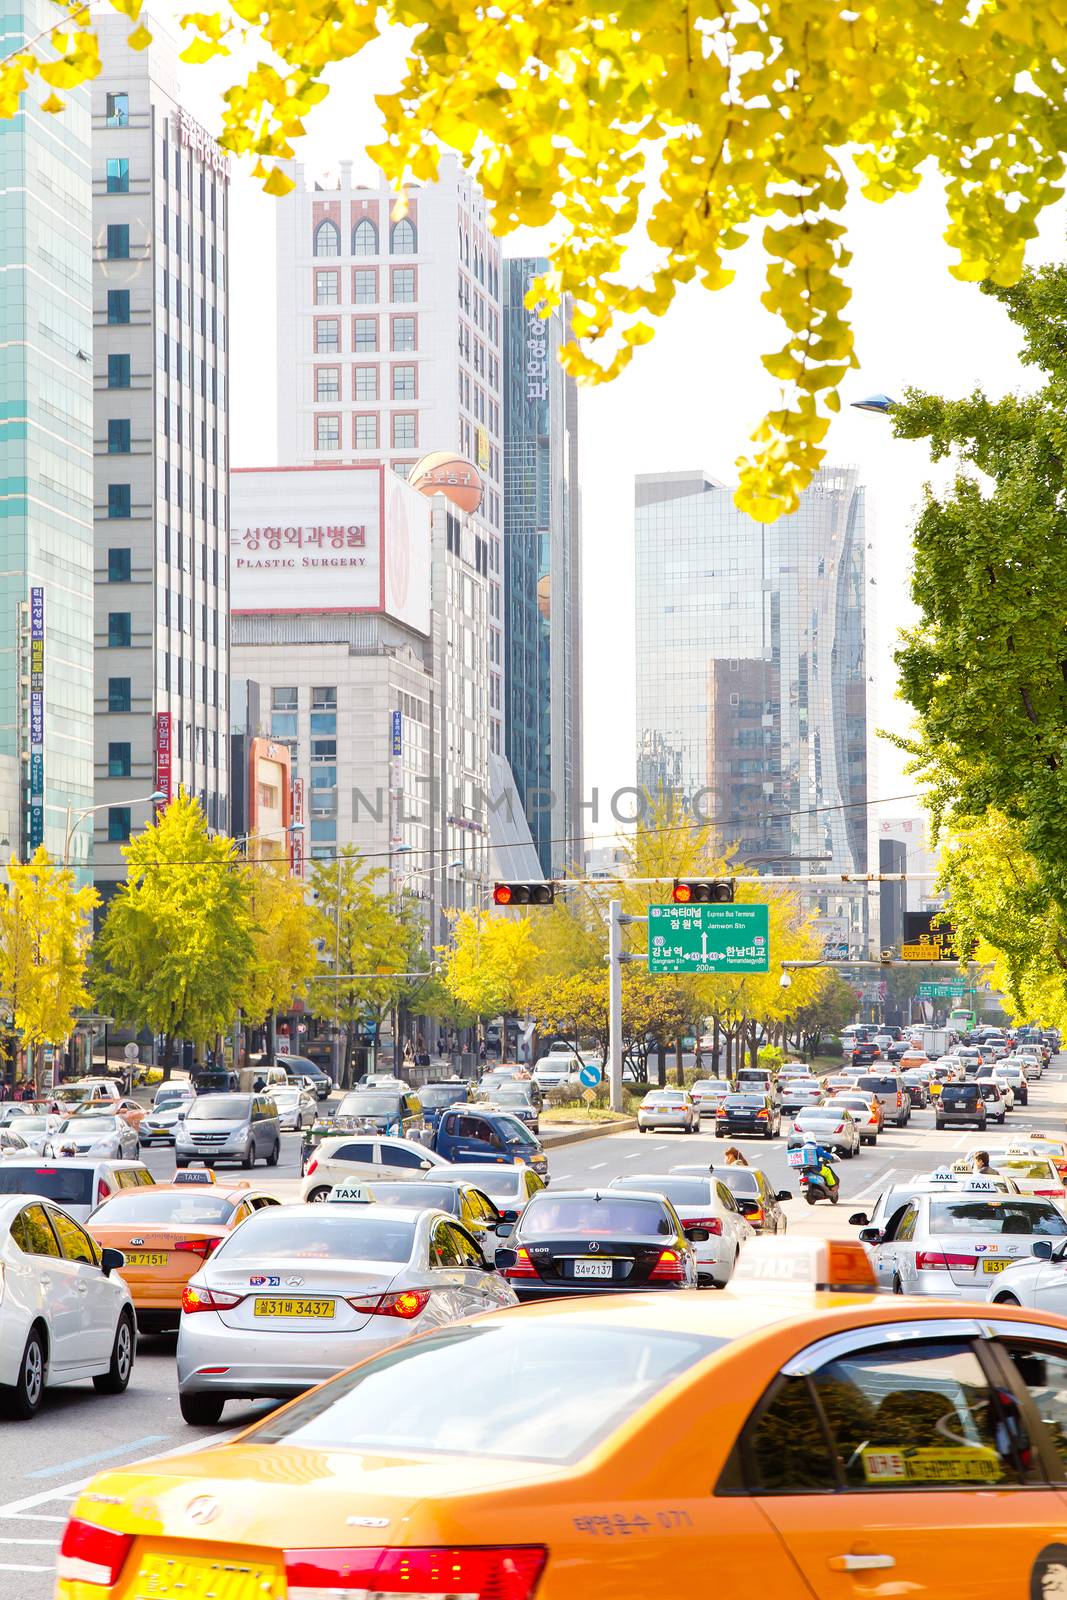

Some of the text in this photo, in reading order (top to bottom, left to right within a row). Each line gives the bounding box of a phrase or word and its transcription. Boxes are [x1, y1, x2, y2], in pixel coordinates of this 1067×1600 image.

[662, 907, 702, 918] 고속터미널
[670, 919, 702, 930] 잠원역
[652, 946, 683, 957] 강남역
[726, 946, 766, 957] 한남대교
[696, 964, 715, 972] 200m
[336, 1190, 361, 1198] TAXI
[140, 1254, 164, 1264] 7151
[591, 1265, 612, 1275] 2137
[296, 1301, 329, 1315] 3437
